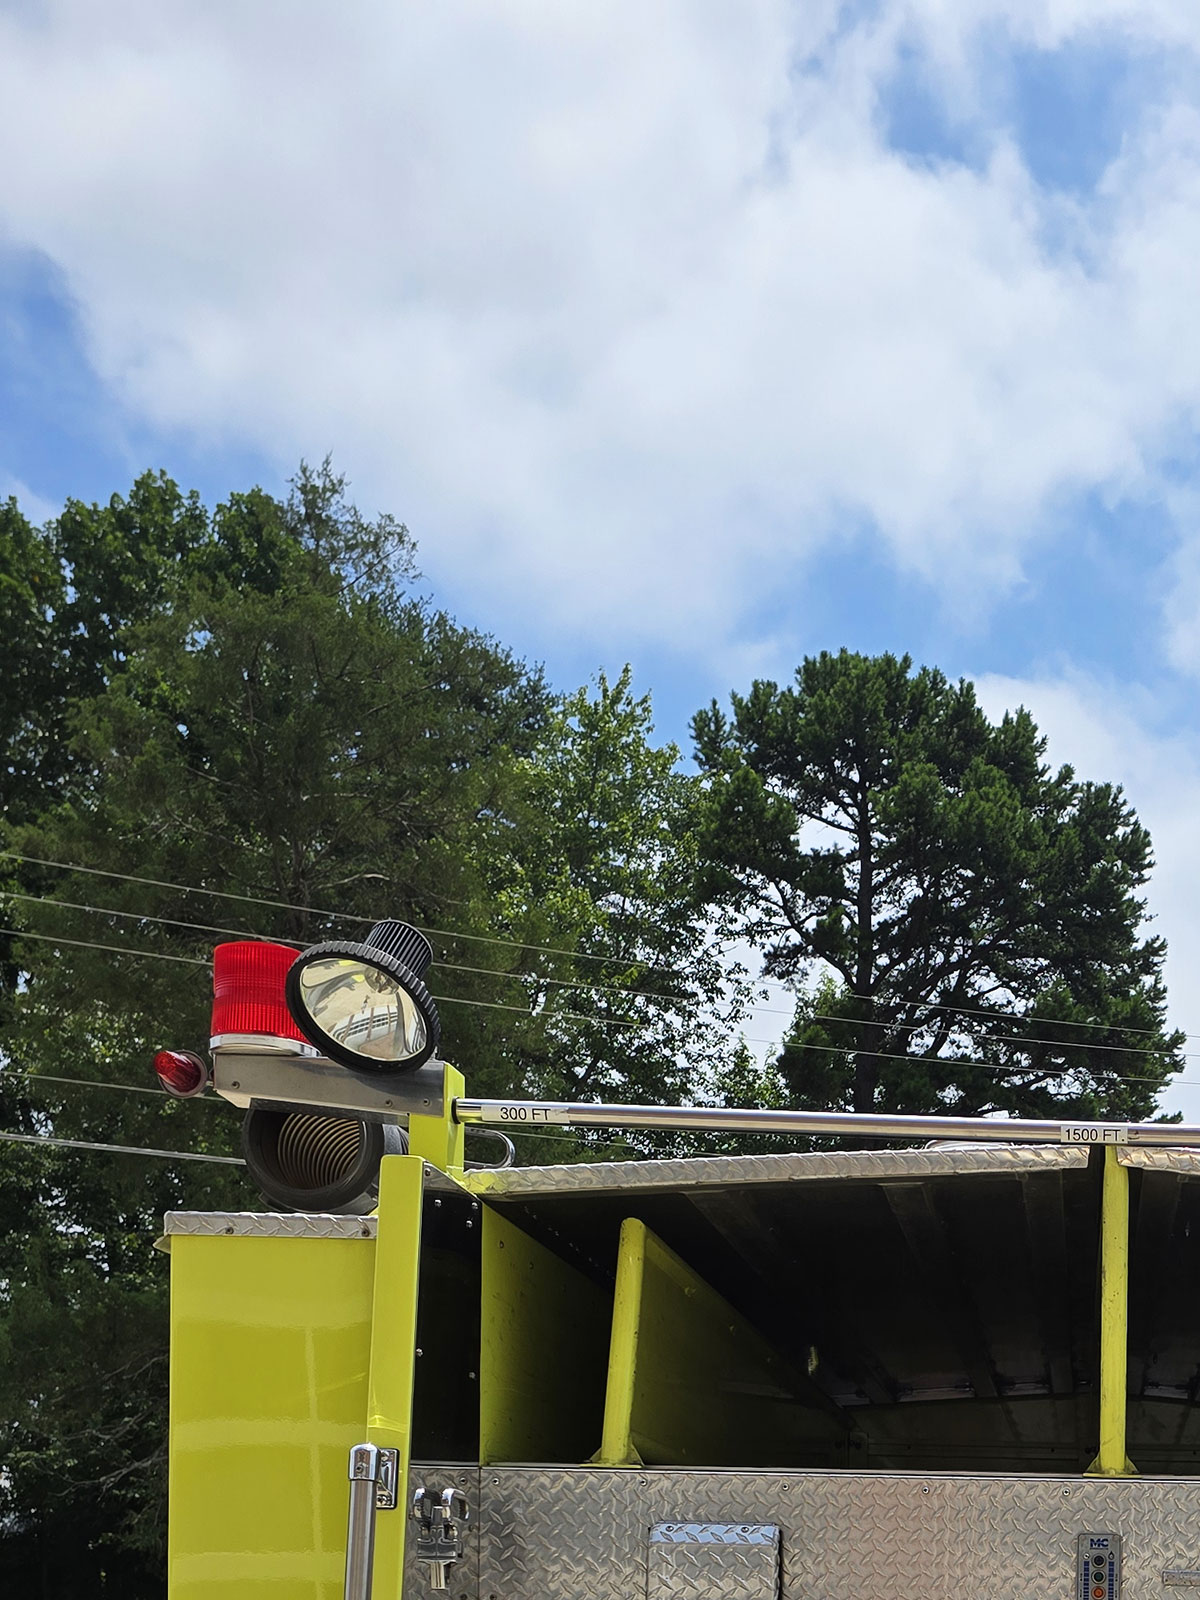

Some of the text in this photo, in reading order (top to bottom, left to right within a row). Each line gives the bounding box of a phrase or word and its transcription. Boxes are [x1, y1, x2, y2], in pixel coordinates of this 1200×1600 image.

[500, 1107, 550, 1121] 300 FT
[1065, 1129, 1124, 1142] 1500 FT.
[1090, 1539, 1108, 1548] MC
